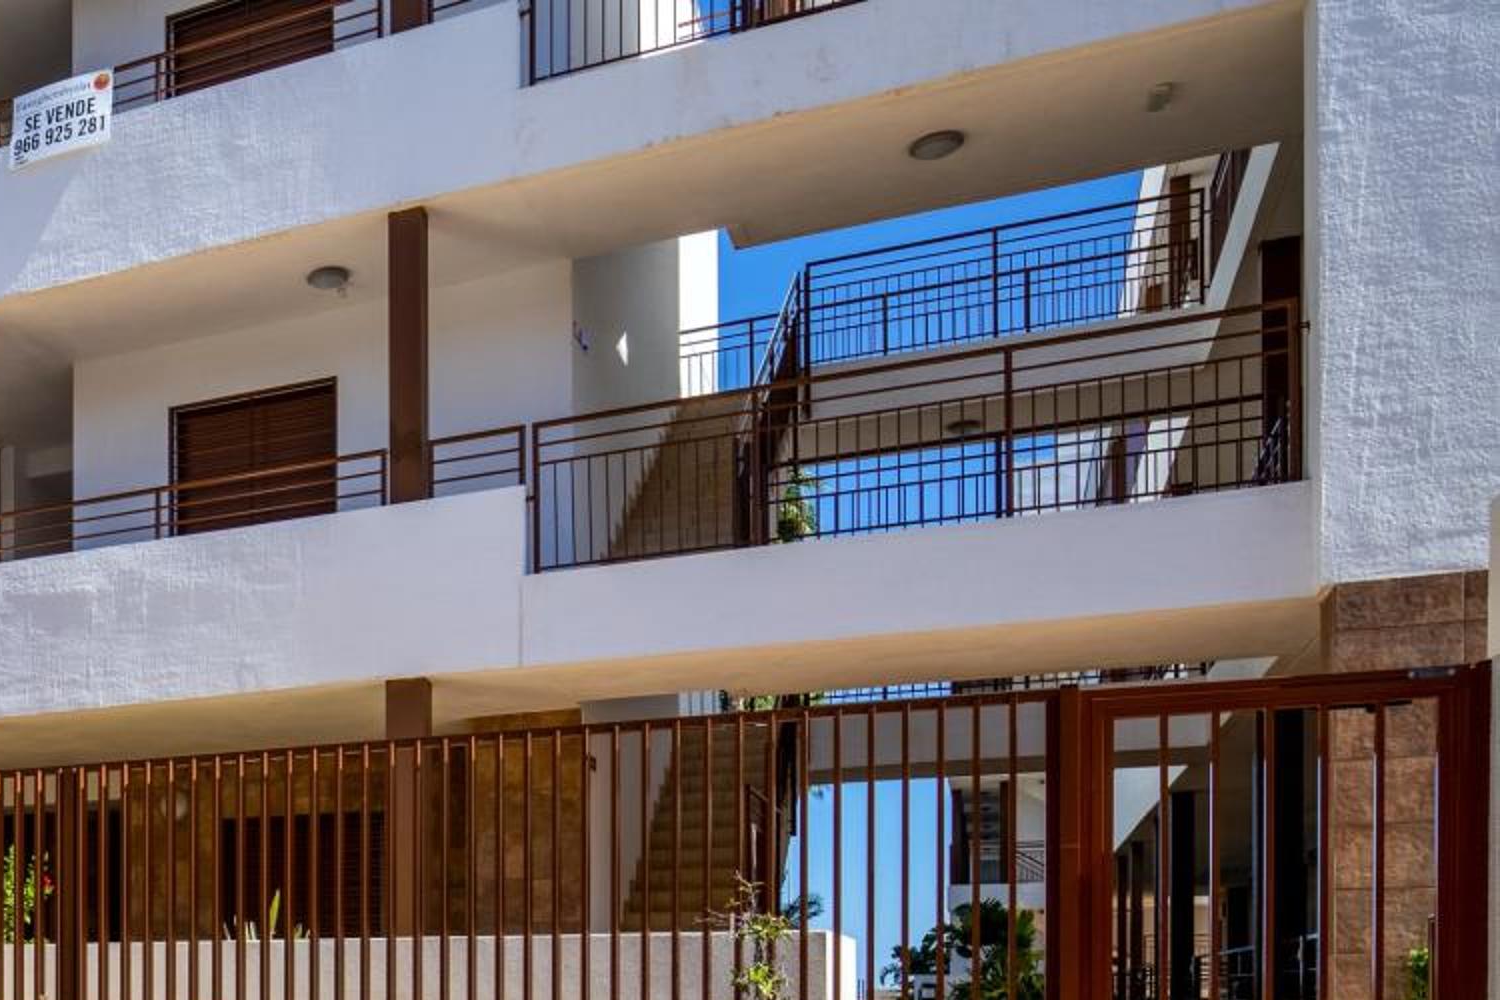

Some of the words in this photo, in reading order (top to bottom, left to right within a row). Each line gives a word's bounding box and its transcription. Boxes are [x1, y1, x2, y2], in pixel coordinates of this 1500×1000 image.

[23, 113, 42, 133] SE
[46, 97, 96, 125] VENDE
[13, 133, 40, 156] 966
[45, 122, 73, 145] 925
[78, 115, 105, 137] 281
